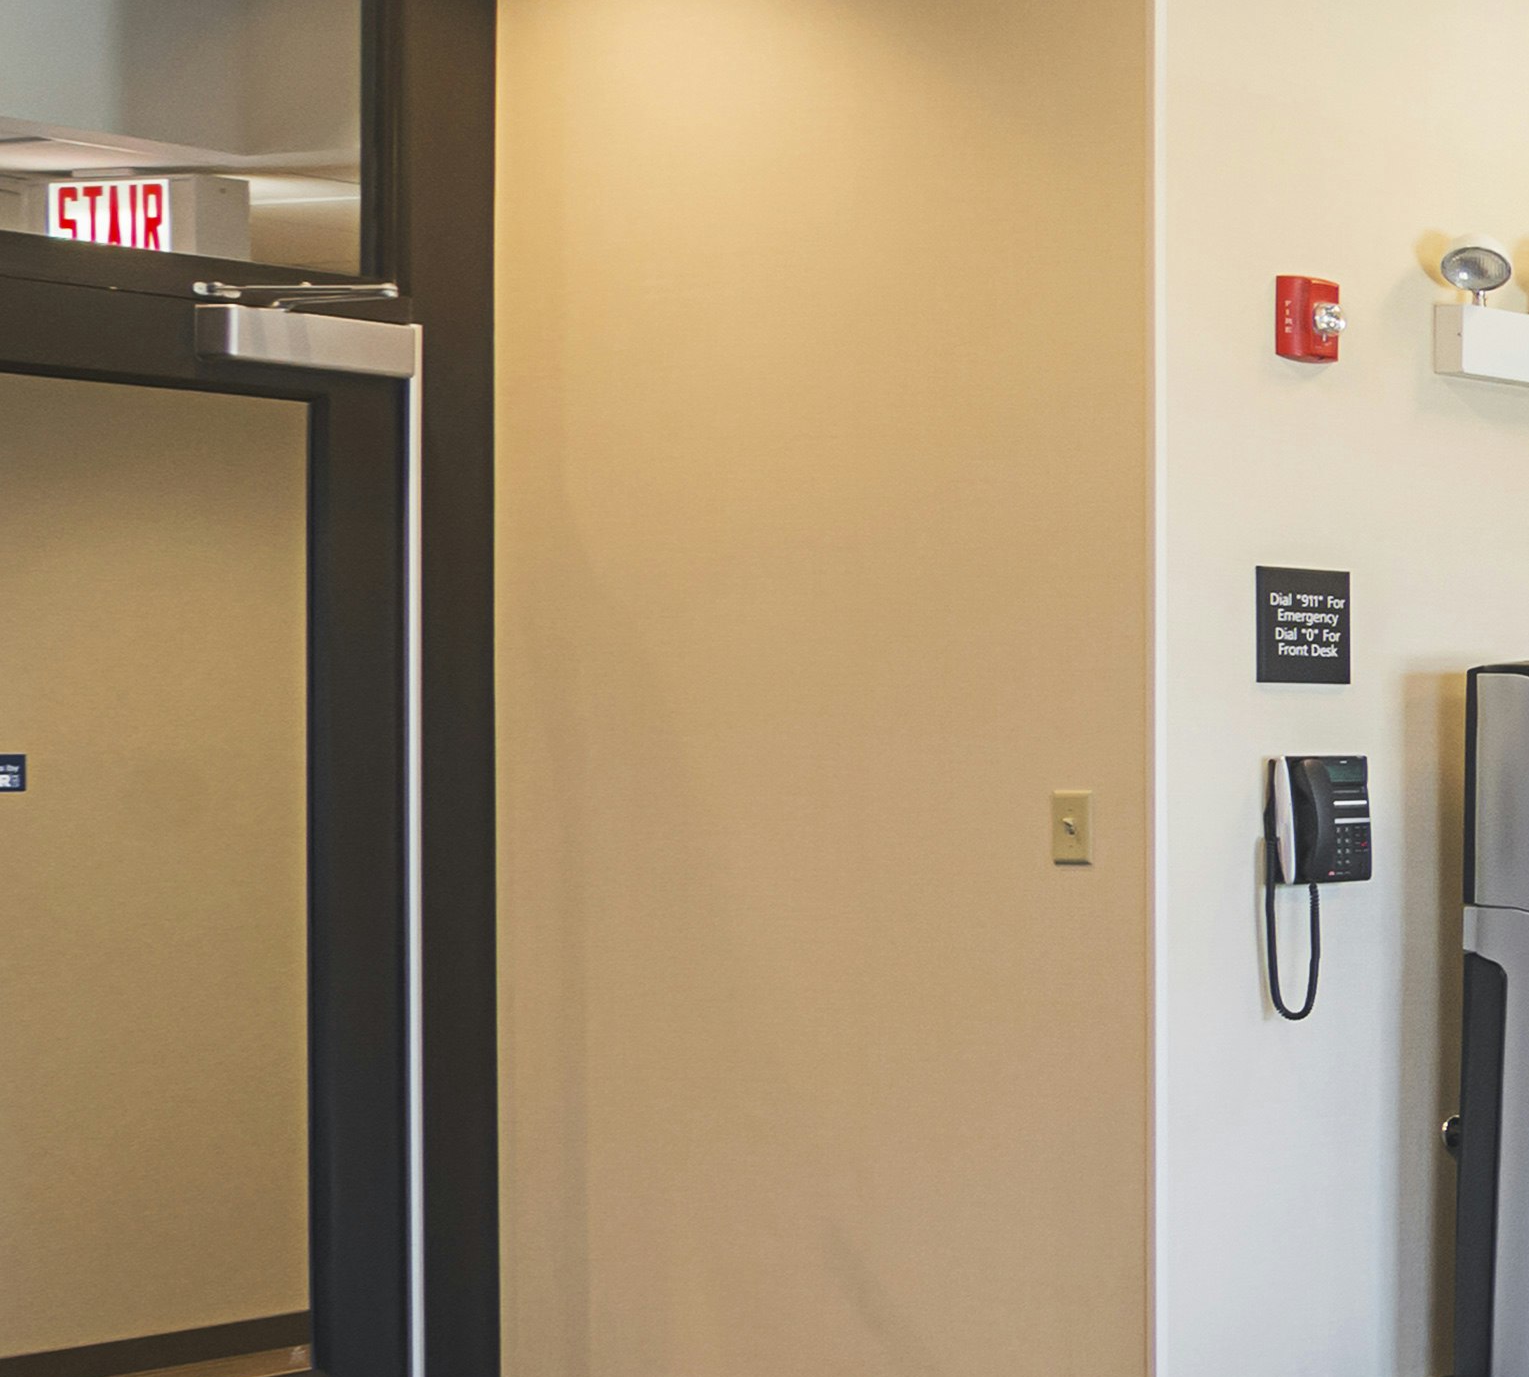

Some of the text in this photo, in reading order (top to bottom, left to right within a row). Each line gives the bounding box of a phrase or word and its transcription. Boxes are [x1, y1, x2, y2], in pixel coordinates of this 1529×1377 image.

[58, 184, 162, 250] STAIR
[1284, 300, 1292, 333] FIRE
[1269, 592, 1345, 609] Dial "911" For
[1277, 608, 1339, 627] Emergency
[1275, 627, 1297, 640] Dial
[1322, 629, 1341, 642] For
[1278, 642, 1338, 657] Front Desk
